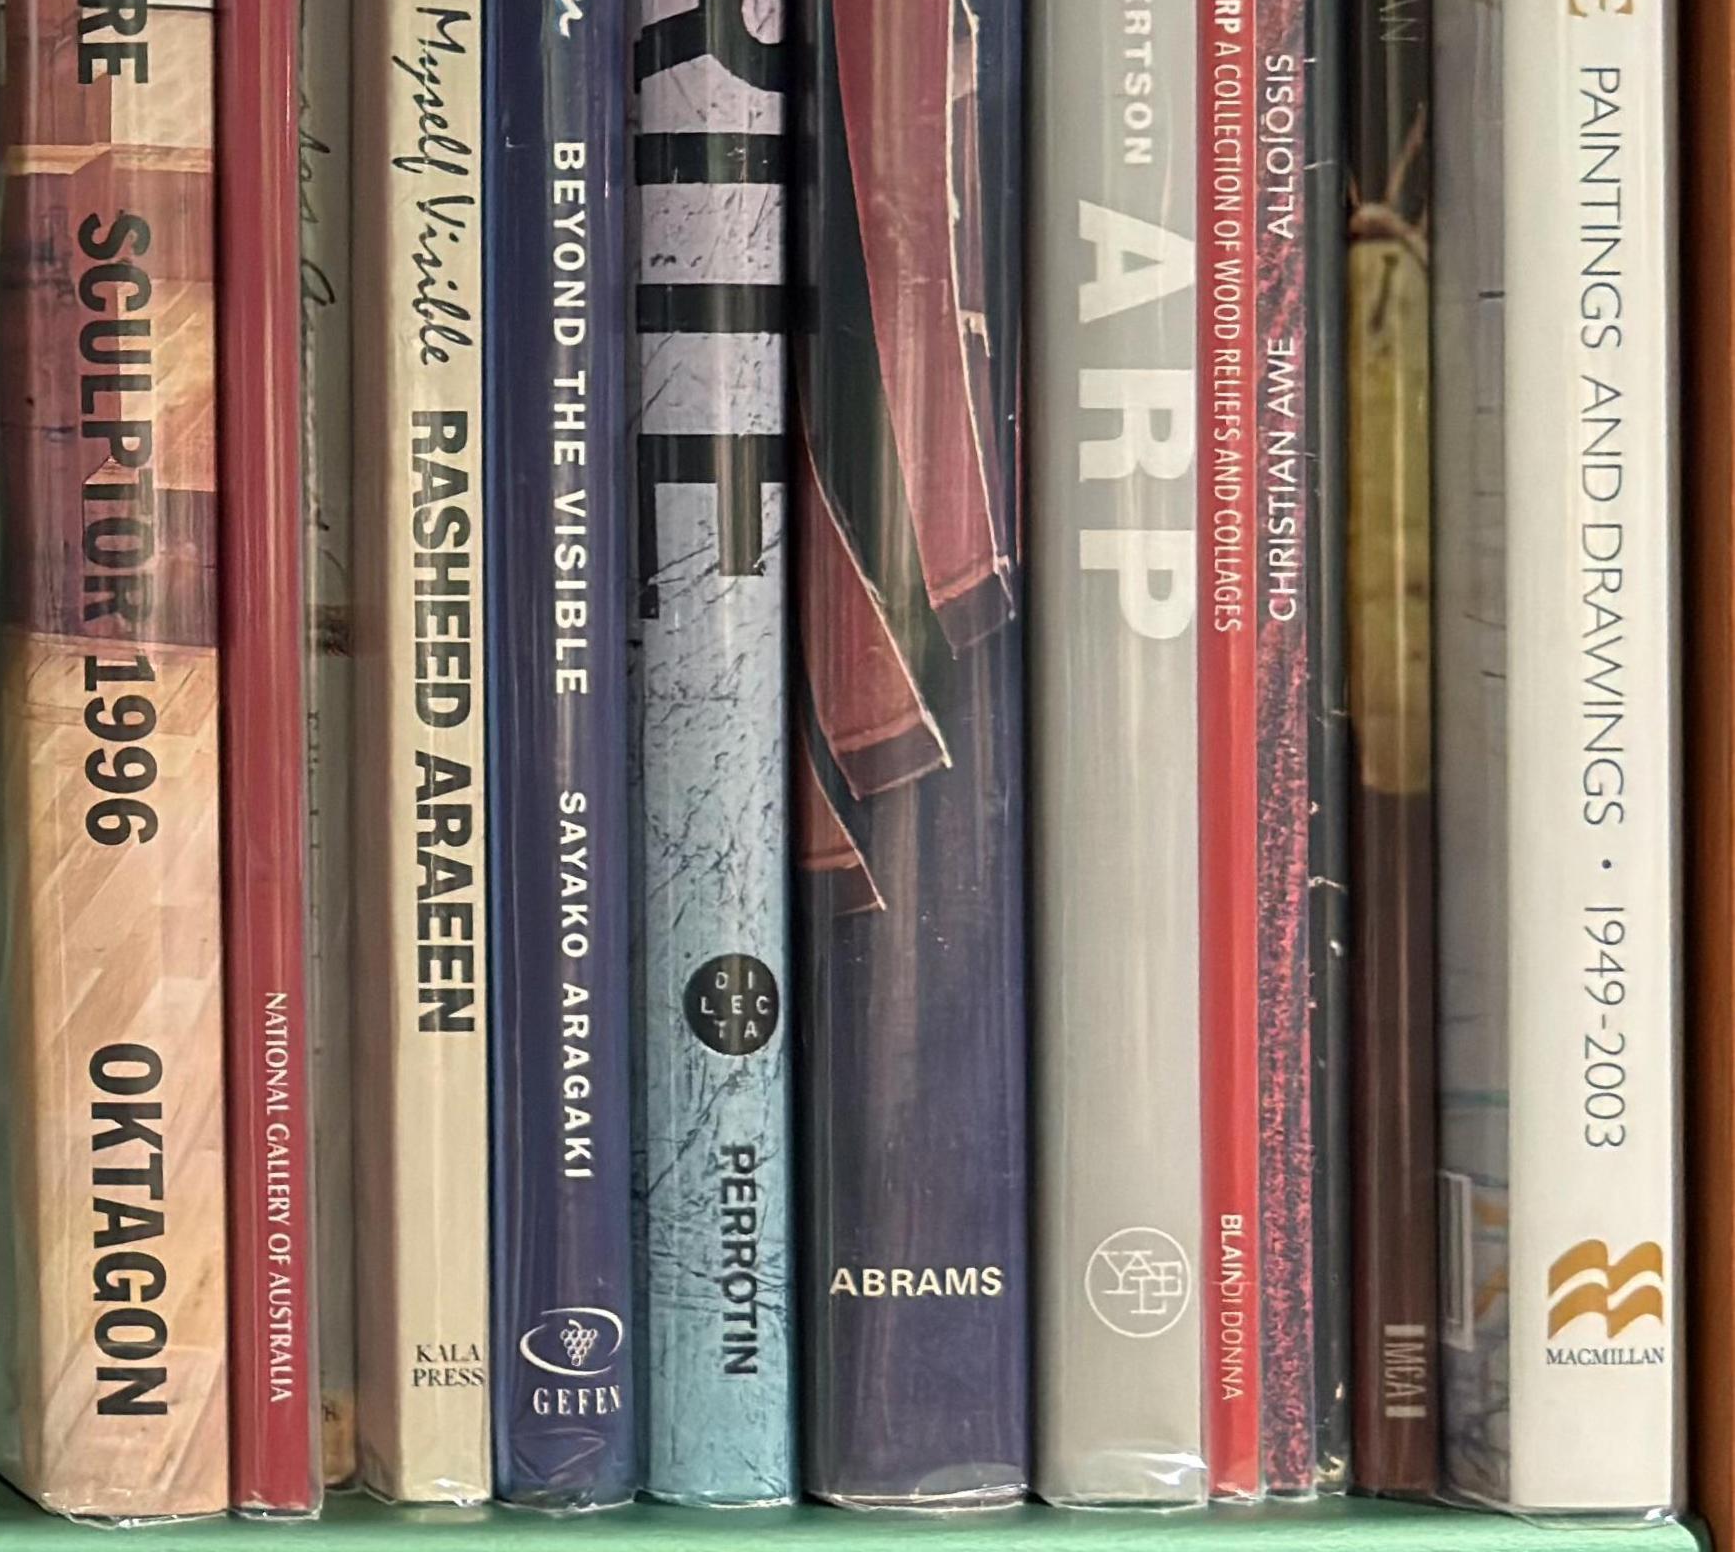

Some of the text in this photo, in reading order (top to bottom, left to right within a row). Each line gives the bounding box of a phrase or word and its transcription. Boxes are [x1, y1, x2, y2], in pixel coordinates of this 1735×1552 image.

[392, 6, 472, 177] Myself
[80, 212, 154, 624] SCULPTOR
[413, 194, 475, 366] Visible
[549, 142, 588, 694] BEYOND THE VISIBLE
[1078, 199, 1196, 641] ARP
[1266, 336, 1298, 623] CHRISTIAN AWE
[1579, 67, 1627, 1148] PAINTINGS AND DRAWINGS 1949-2003
[84, 654, 160, 847] 1996
[412, 410, 475, 1033] RASHEED ARAEEN
[559, 790, 593, 1178] SAYAKO ARAGAKI
[89, 1042, 169, 1417] OKTAGON
[828, 1263, 1005, 1299] ABRAMS
[1545, 1346, 1667, 1366] MACMILLAN
